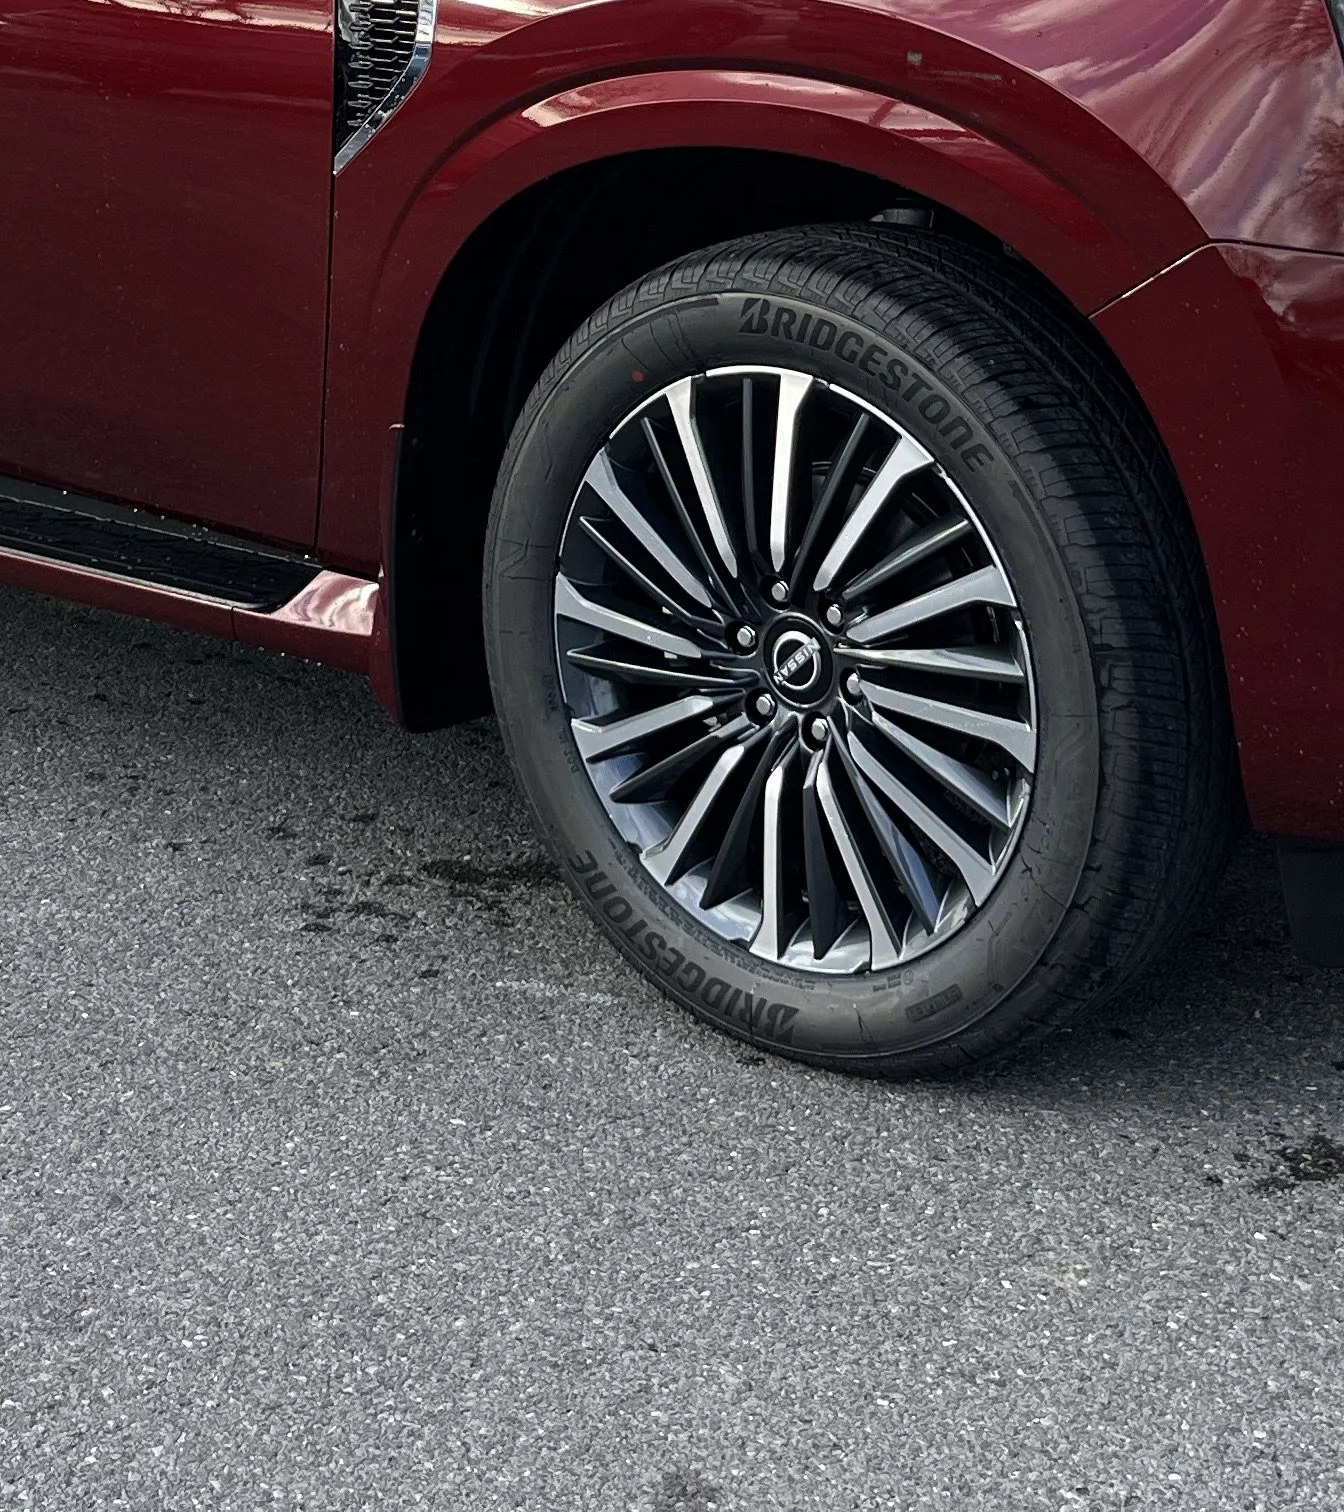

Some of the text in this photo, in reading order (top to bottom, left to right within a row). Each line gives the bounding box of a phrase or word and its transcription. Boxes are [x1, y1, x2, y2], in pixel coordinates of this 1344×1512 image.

[738, 297, 996, 474] BRIDGESTONE
[773, 637, 821, 685] NISSAN
[566, 848, 800, 1045] BRIDGESTONE
